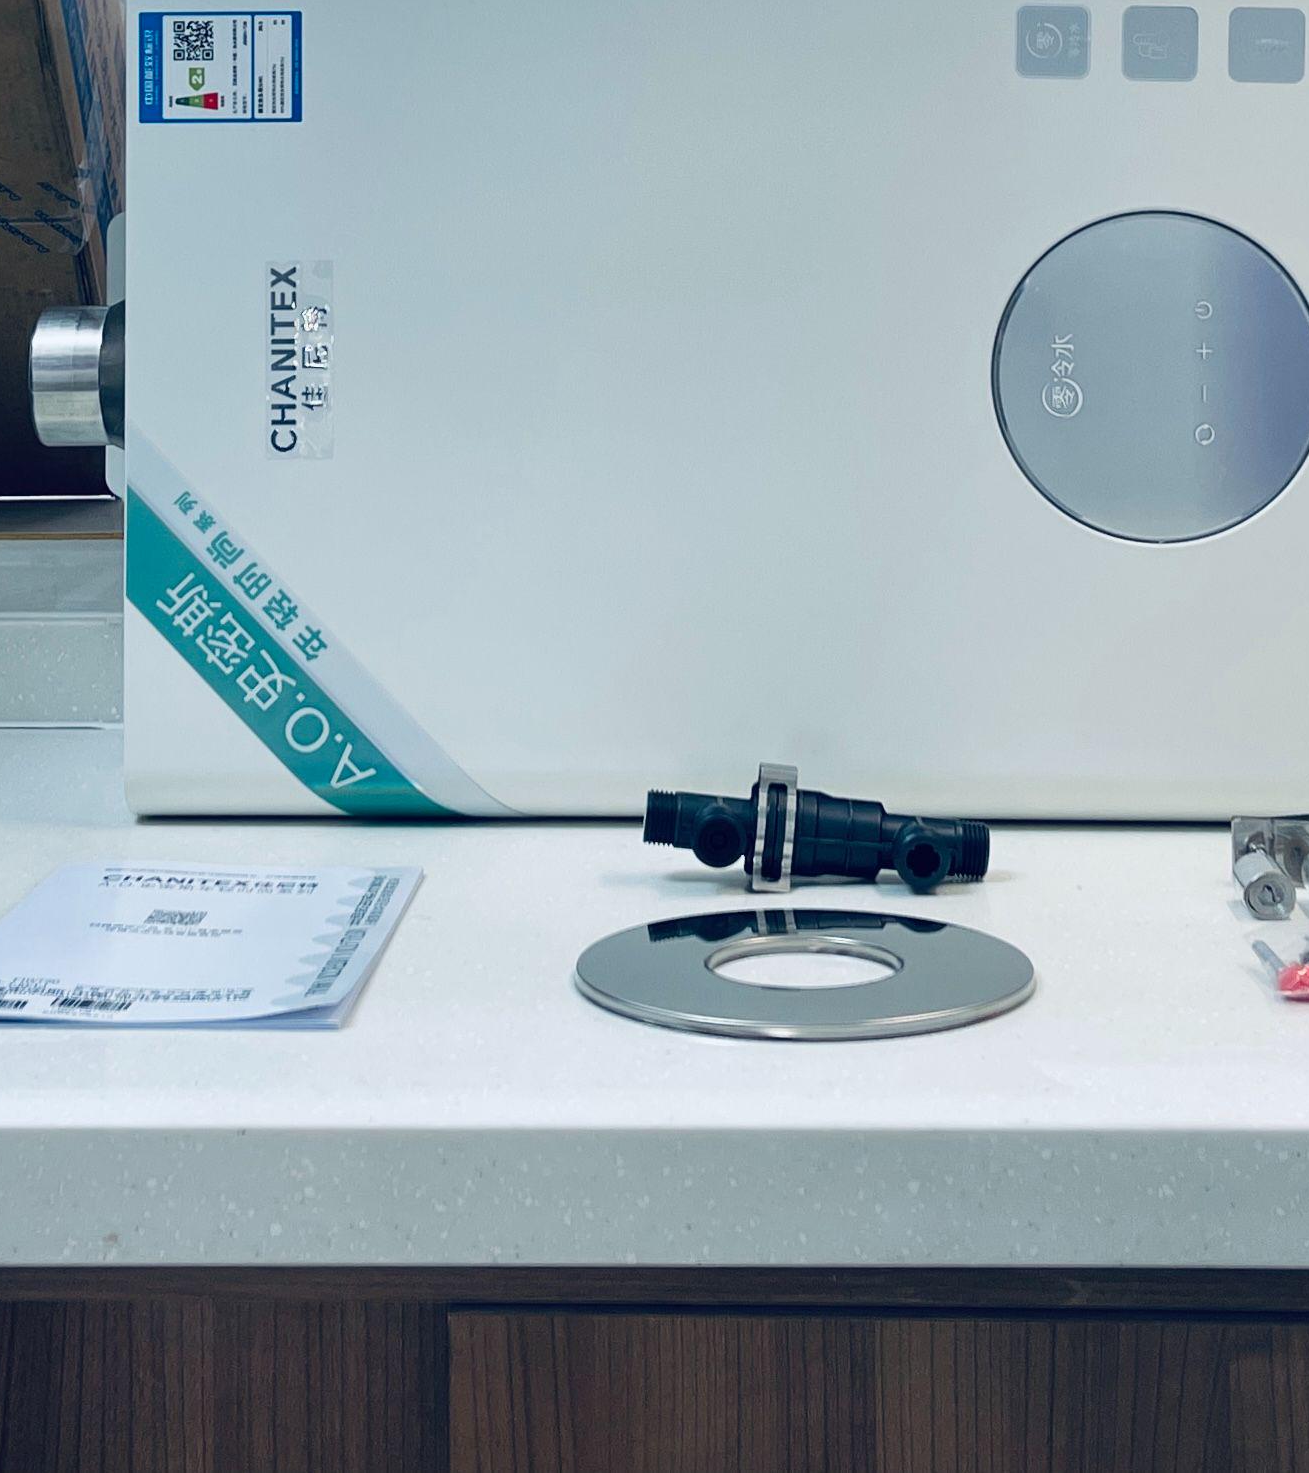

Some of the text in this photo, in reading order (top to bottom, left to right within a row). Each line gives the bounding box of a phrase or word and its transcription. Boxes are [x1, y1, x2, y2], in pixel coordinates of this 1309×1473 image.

[270, 266, 297, 453] CHANITEX
[174, 491, 328, 662] 年轻时尚系列
[156, 572, 377, 789] A.O.史密斯
